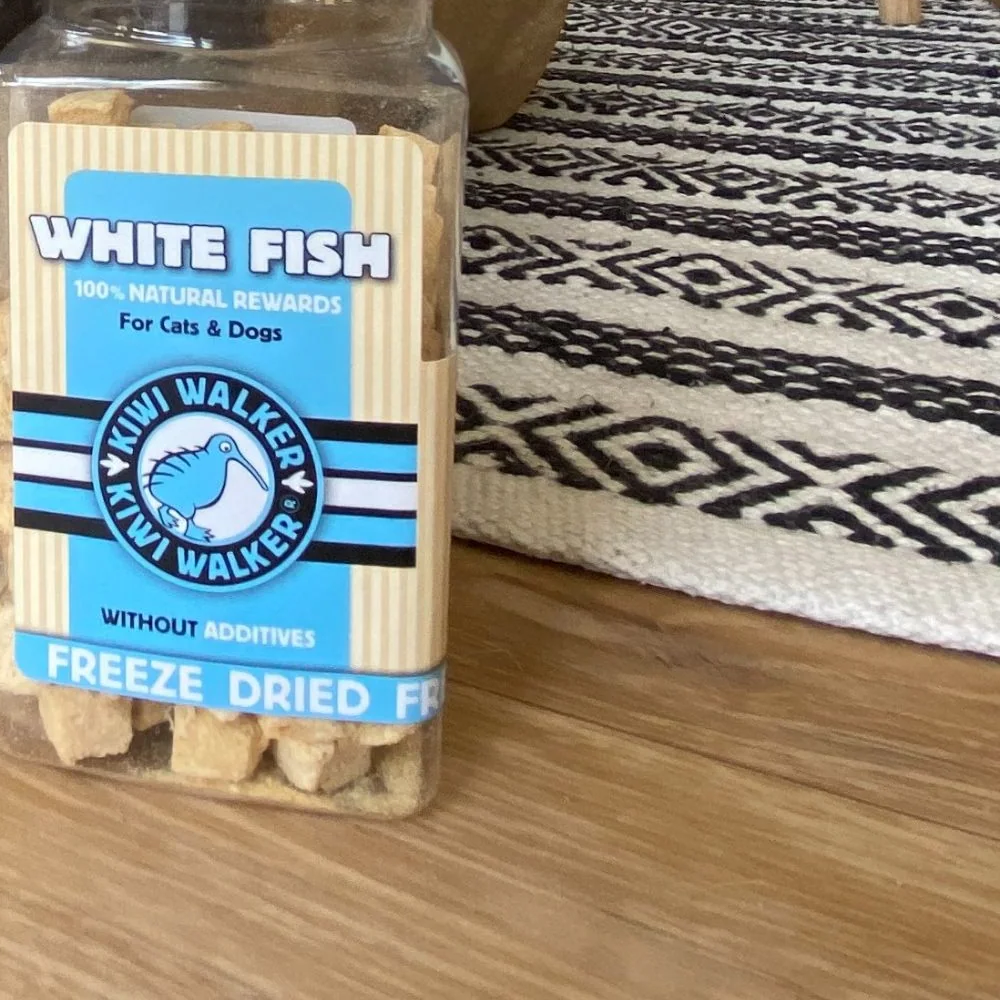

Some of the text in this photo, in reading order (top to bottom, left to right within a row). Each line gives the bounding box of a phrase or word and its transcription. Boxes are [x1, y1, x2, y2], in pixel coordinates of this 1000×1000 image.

[29, 214, 392, 280] WHITE FISH
[74, 279, 342, 315] 100% NATURAL REWARDS
[119, 312, 283, 342] For Cats & Dogs
[107, 376, 305, 470] KIWI WALKER
[106, 482, 170, 562] KIWI
[100, 607, 316, 649] WITHOUT ADDITIVES
[47, 643, 204, 702] FREEZE
[229, 670, 371, 717] DRIED
